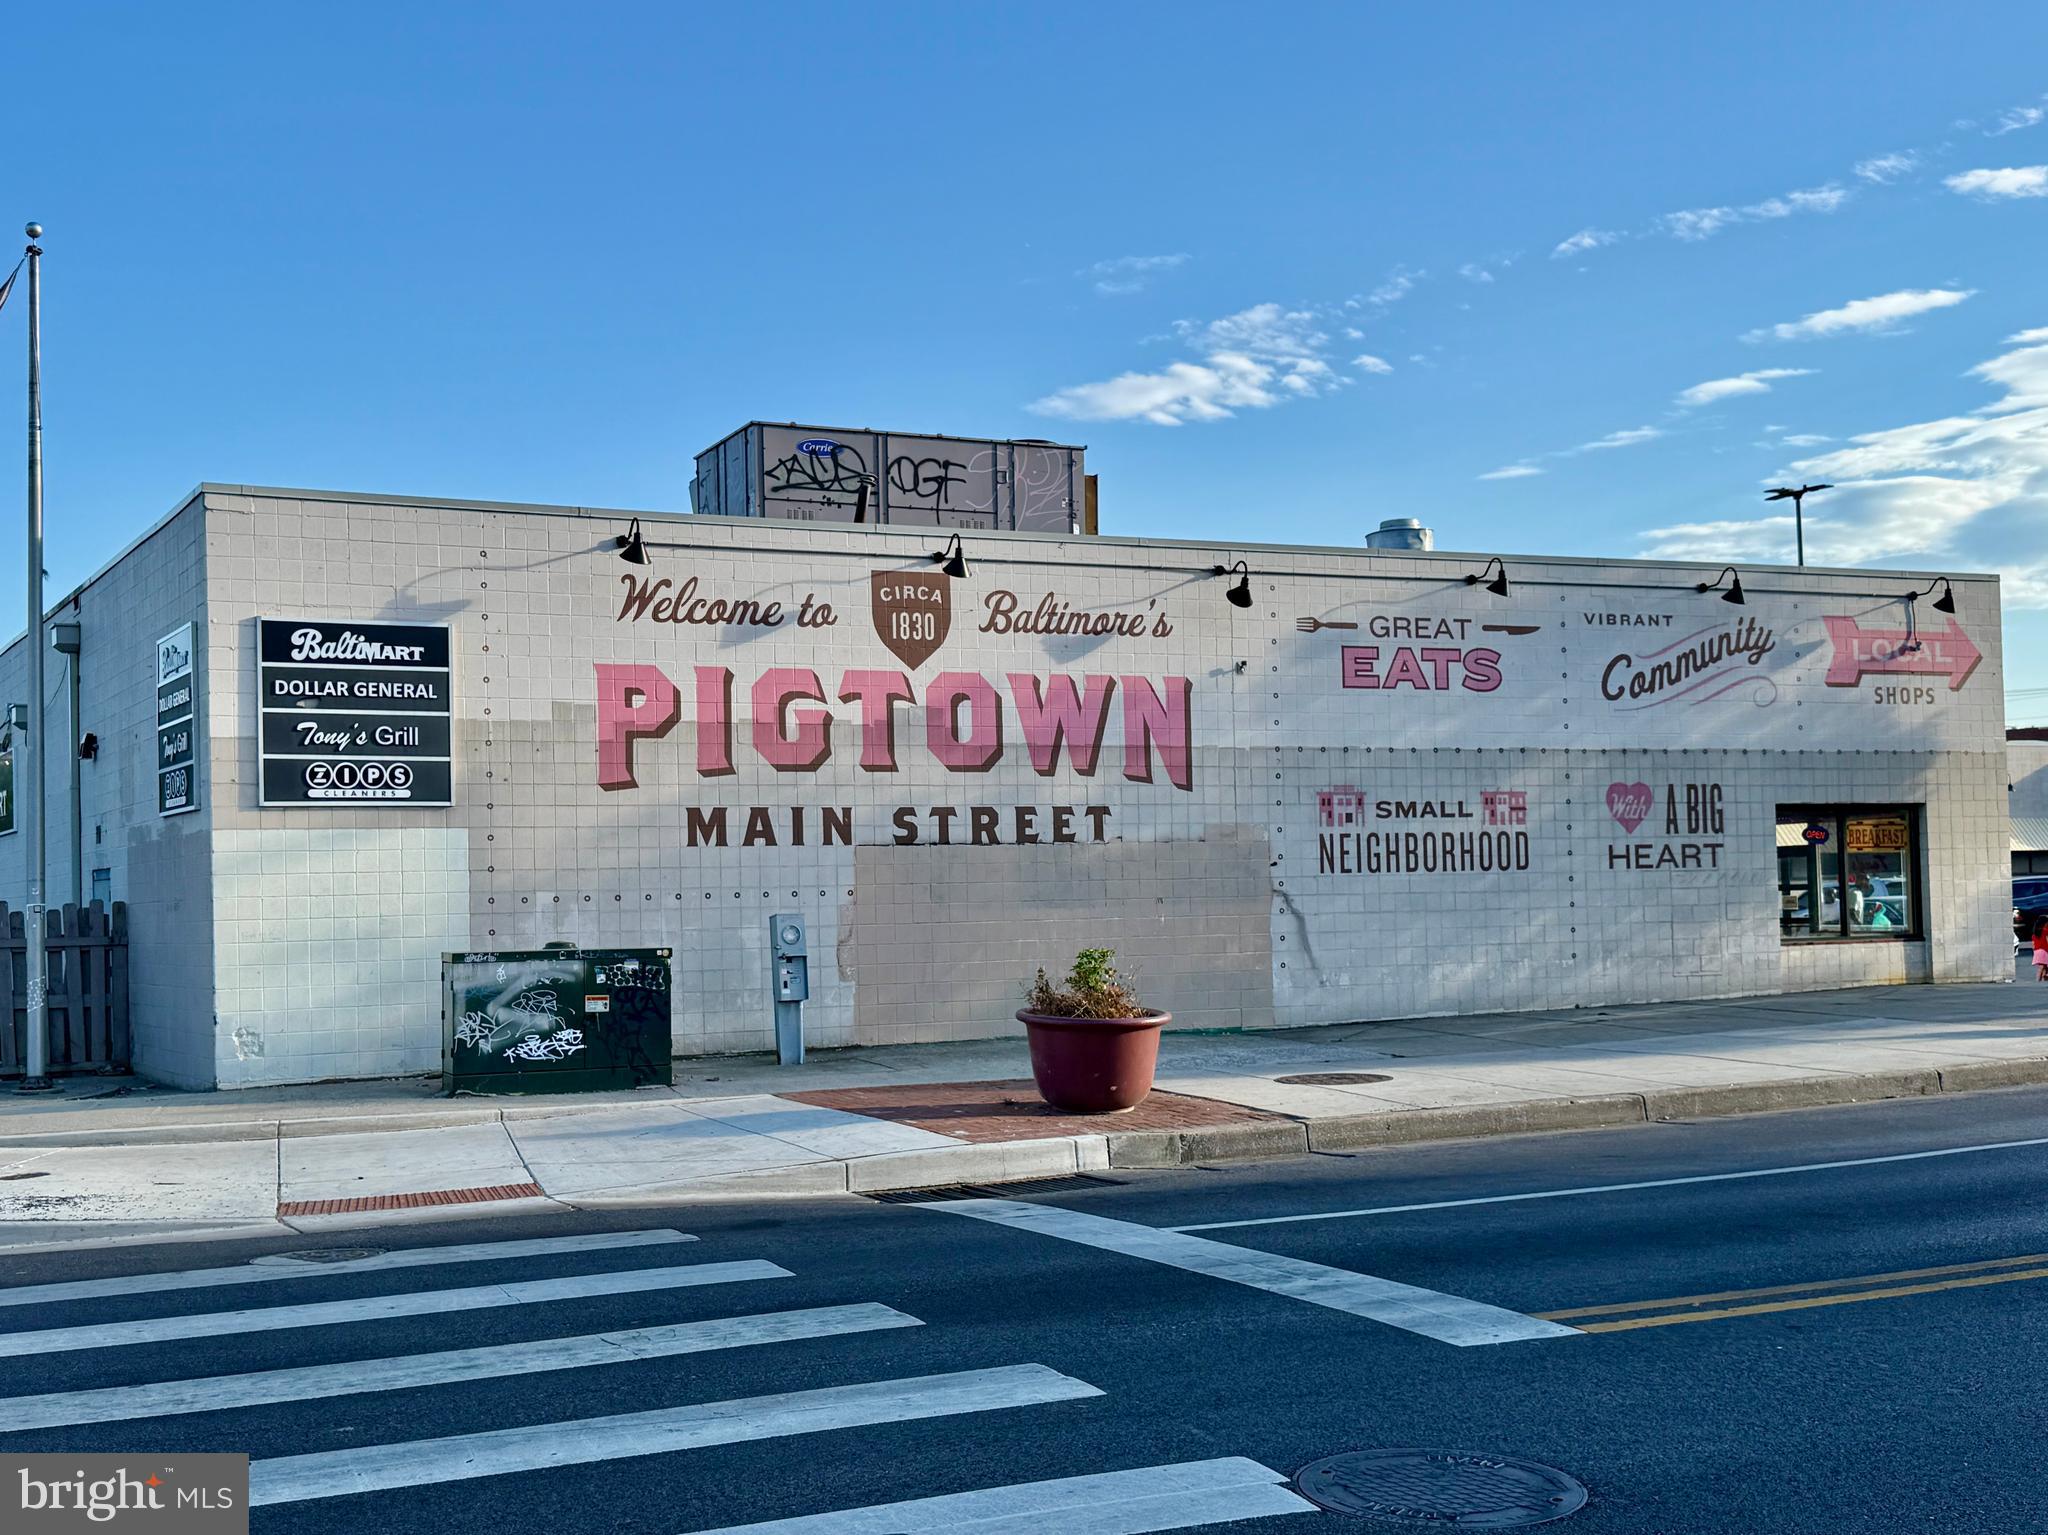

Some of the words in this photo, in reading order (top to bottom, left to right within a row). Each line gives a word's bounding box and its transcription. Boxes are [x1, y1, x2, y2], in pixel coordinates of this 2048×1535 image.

[802, 442, 836, 453] Carrie
[616, 573, 785, 627] Welcome
[796, 592, 839, 629] to
[879, 585, 944, 604] CIRCA
[891, 611, 936, 642] 1830
[978, 589, 1174, 638] Baltimore's
[1583, 612, 1674, 627] VIBRANT
[1369, 615, 1472, 640] GREAT
[1341, 645, 1503, 692] EATS
[1601, 616, 1776, 701] Community
[275, 679, 349, 697] DOLLAR
[353, 682, 437, 699] GENERAL
[1874, 686, 1935, 705] SHOPS
[296, 721, 368, 752] Tony's
[375, 725, 419, 746] Grill
[593, 663, 1193, 792] PIGTOWN
[310, 764, 409, 786] ZIPS
[1375, 800, 1474, 819] SMALL
[1610, 793, 1648, 820] With
[1665, 783, 1680, 835] A
[1686, 783, 1725, 834] BIG
[686, 807, 853, 847] MAIN
[892, 806, 1112, 846] STREET
[1806, 830, 1826, 839] OPEN
[1848, 828, 1905, 845] BREAKFAST
[1318, 831, 1530, 874] NEIGHBORHOOD
[1608, 843, 1724, 870] HEART
